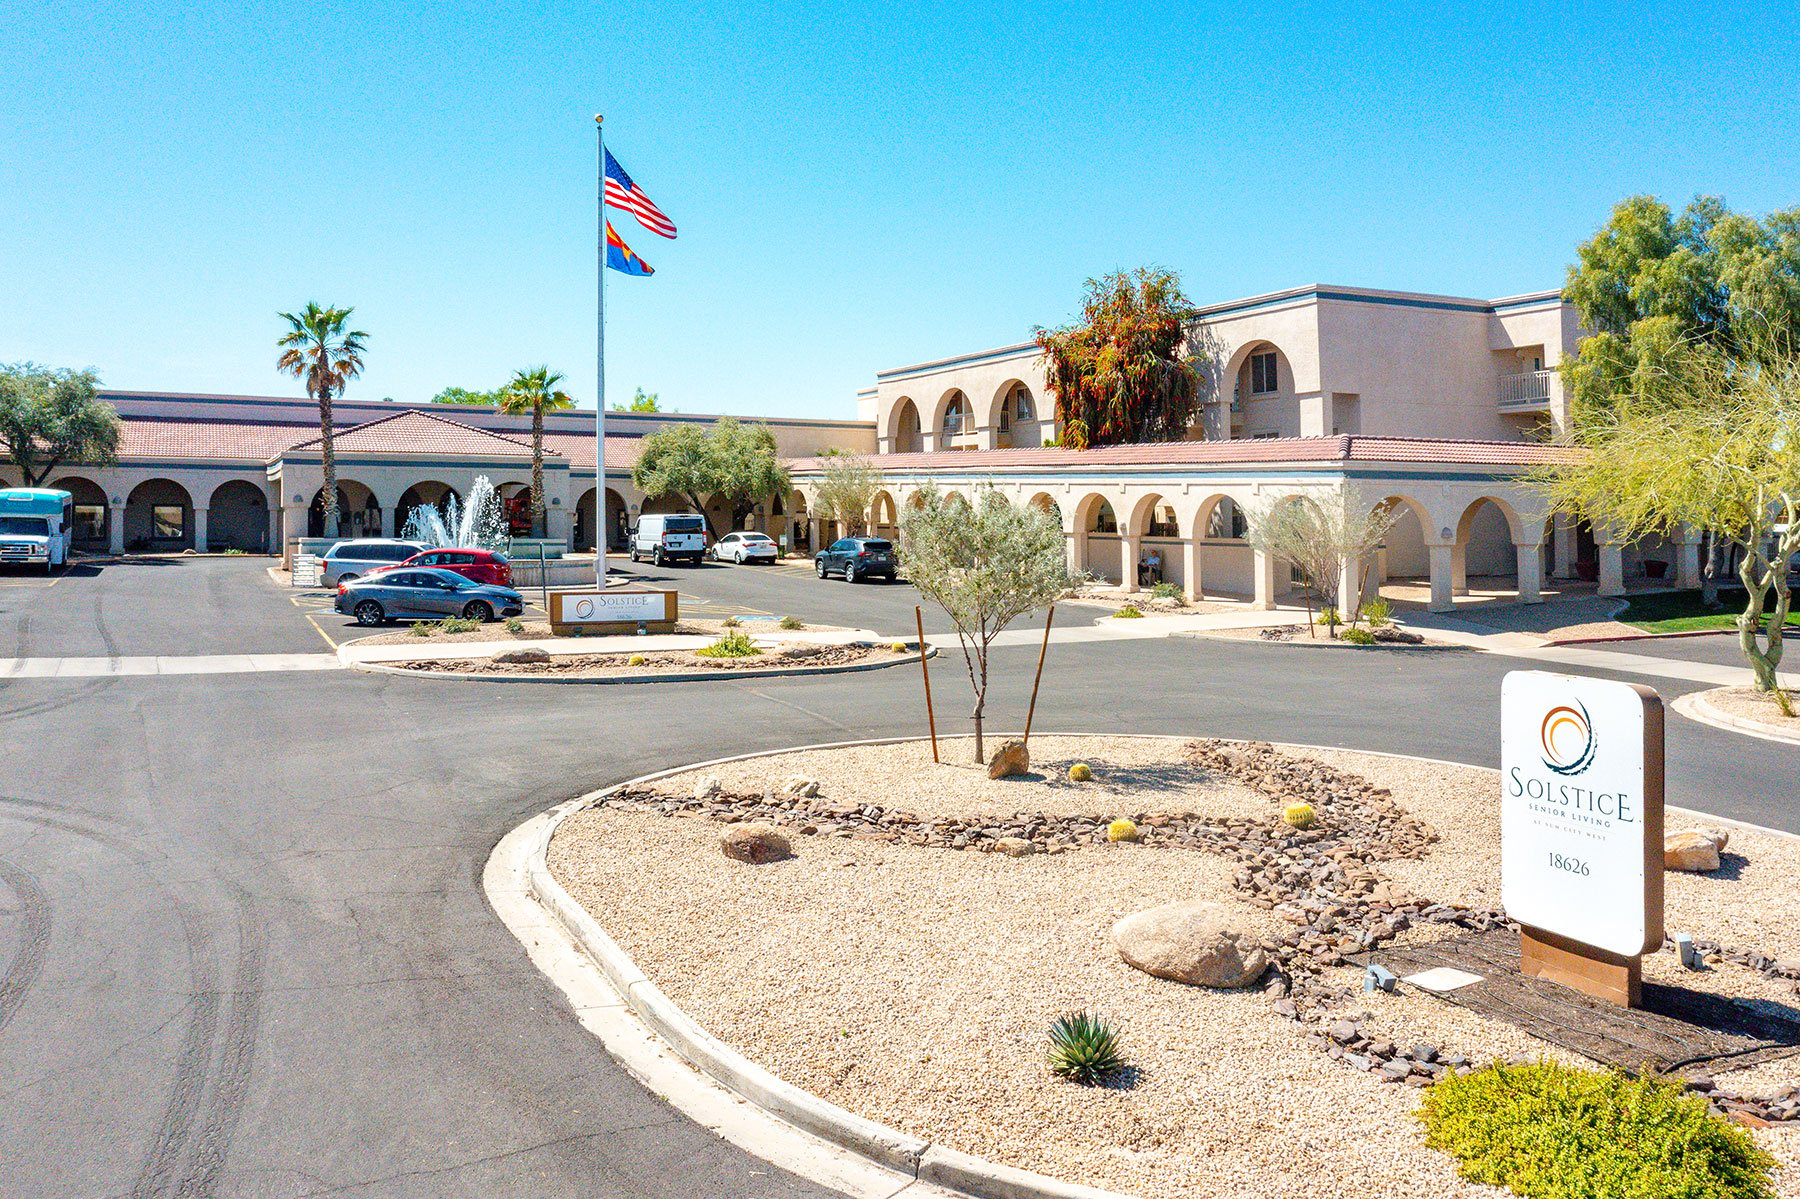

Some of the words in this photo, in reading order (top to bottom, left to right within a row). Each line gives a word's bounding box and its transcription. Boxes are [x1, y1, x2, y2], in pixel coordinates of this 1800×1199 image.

[600, 595, 648, 607] SOLSTICE
[1509, 766, 1634, 822] SOLSTICE
[1529, 803, 1566, 818] SENIOR
[1572, 813, 1611, 828] LIVING
[1549, 852, 1590, 876] 18626
